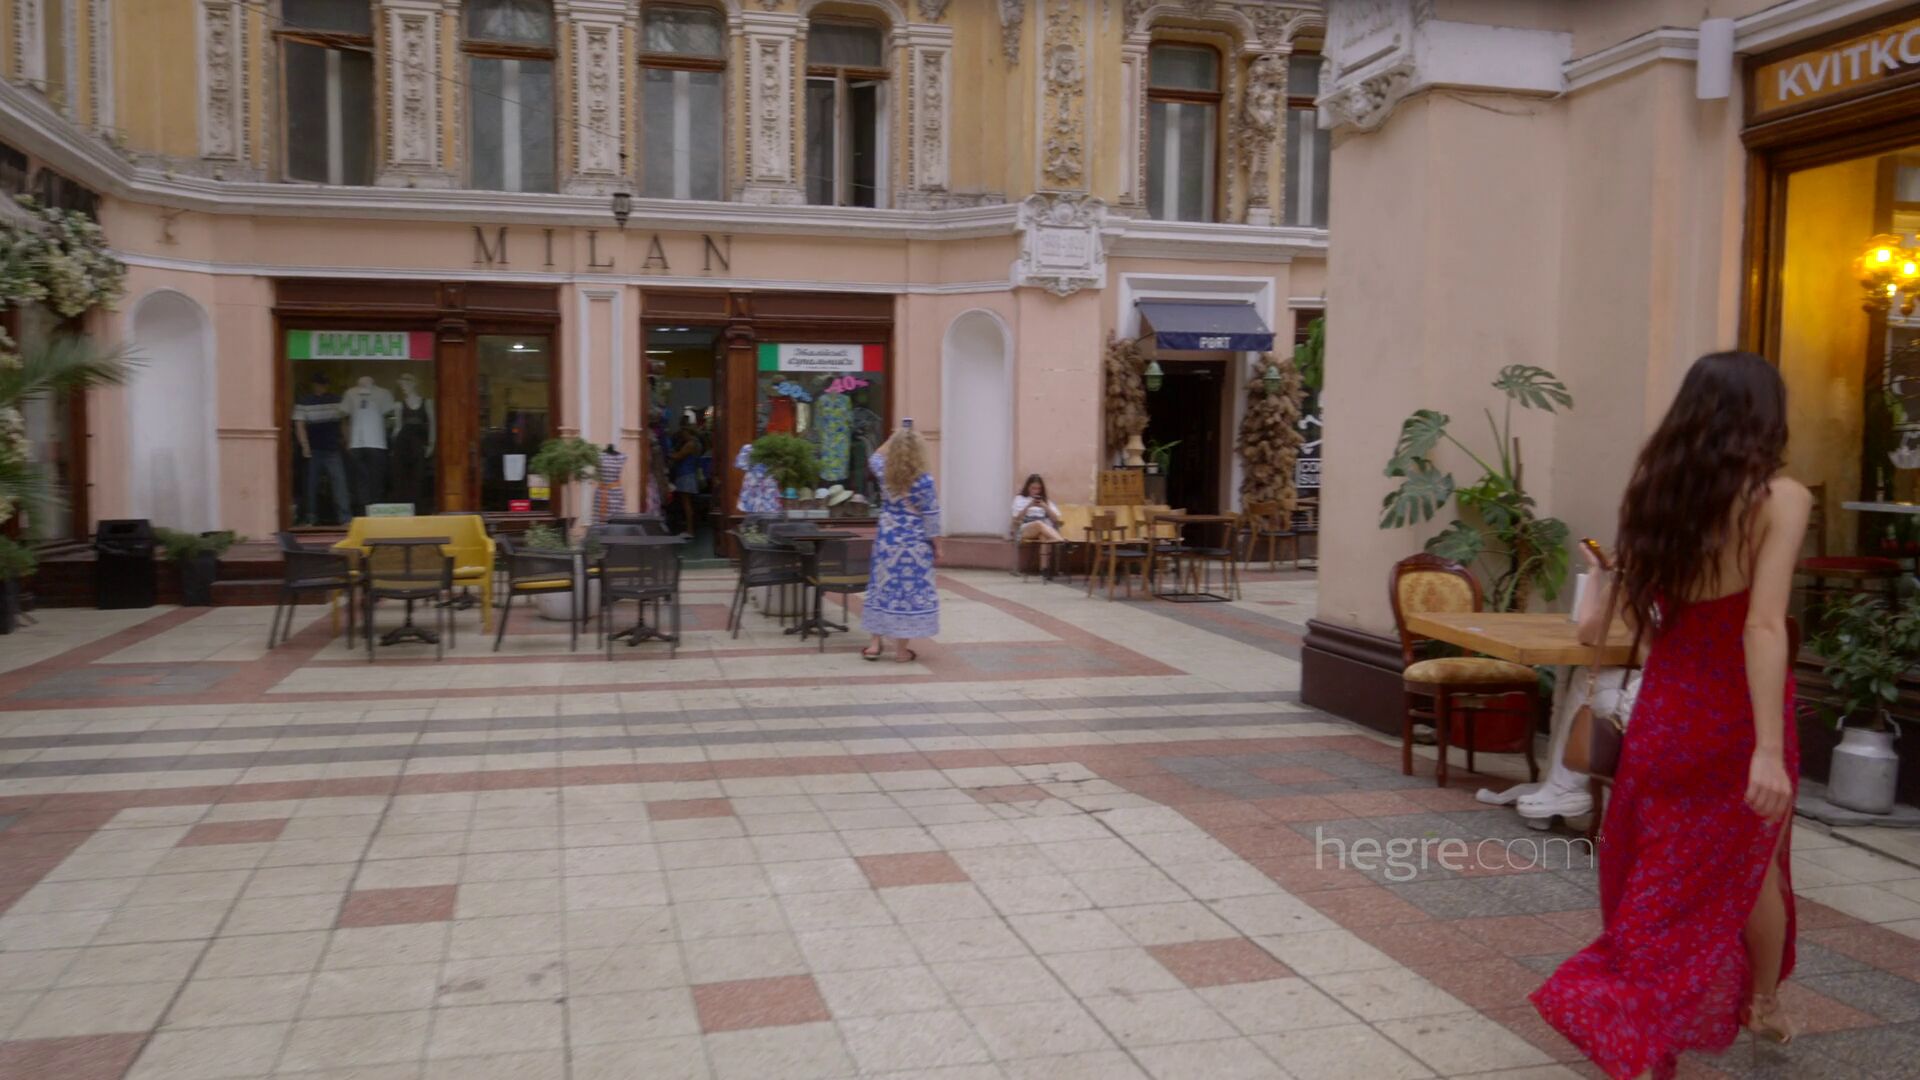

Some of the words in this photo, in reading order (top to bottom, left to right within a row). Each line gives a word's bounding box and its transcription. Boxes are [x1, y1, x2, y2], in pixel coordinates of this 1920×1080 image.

[472, 225, 733, 272] MILAN
[317, 333, 404, 356] МИЛАН
[1199, 336, 1232, 349] PORT
